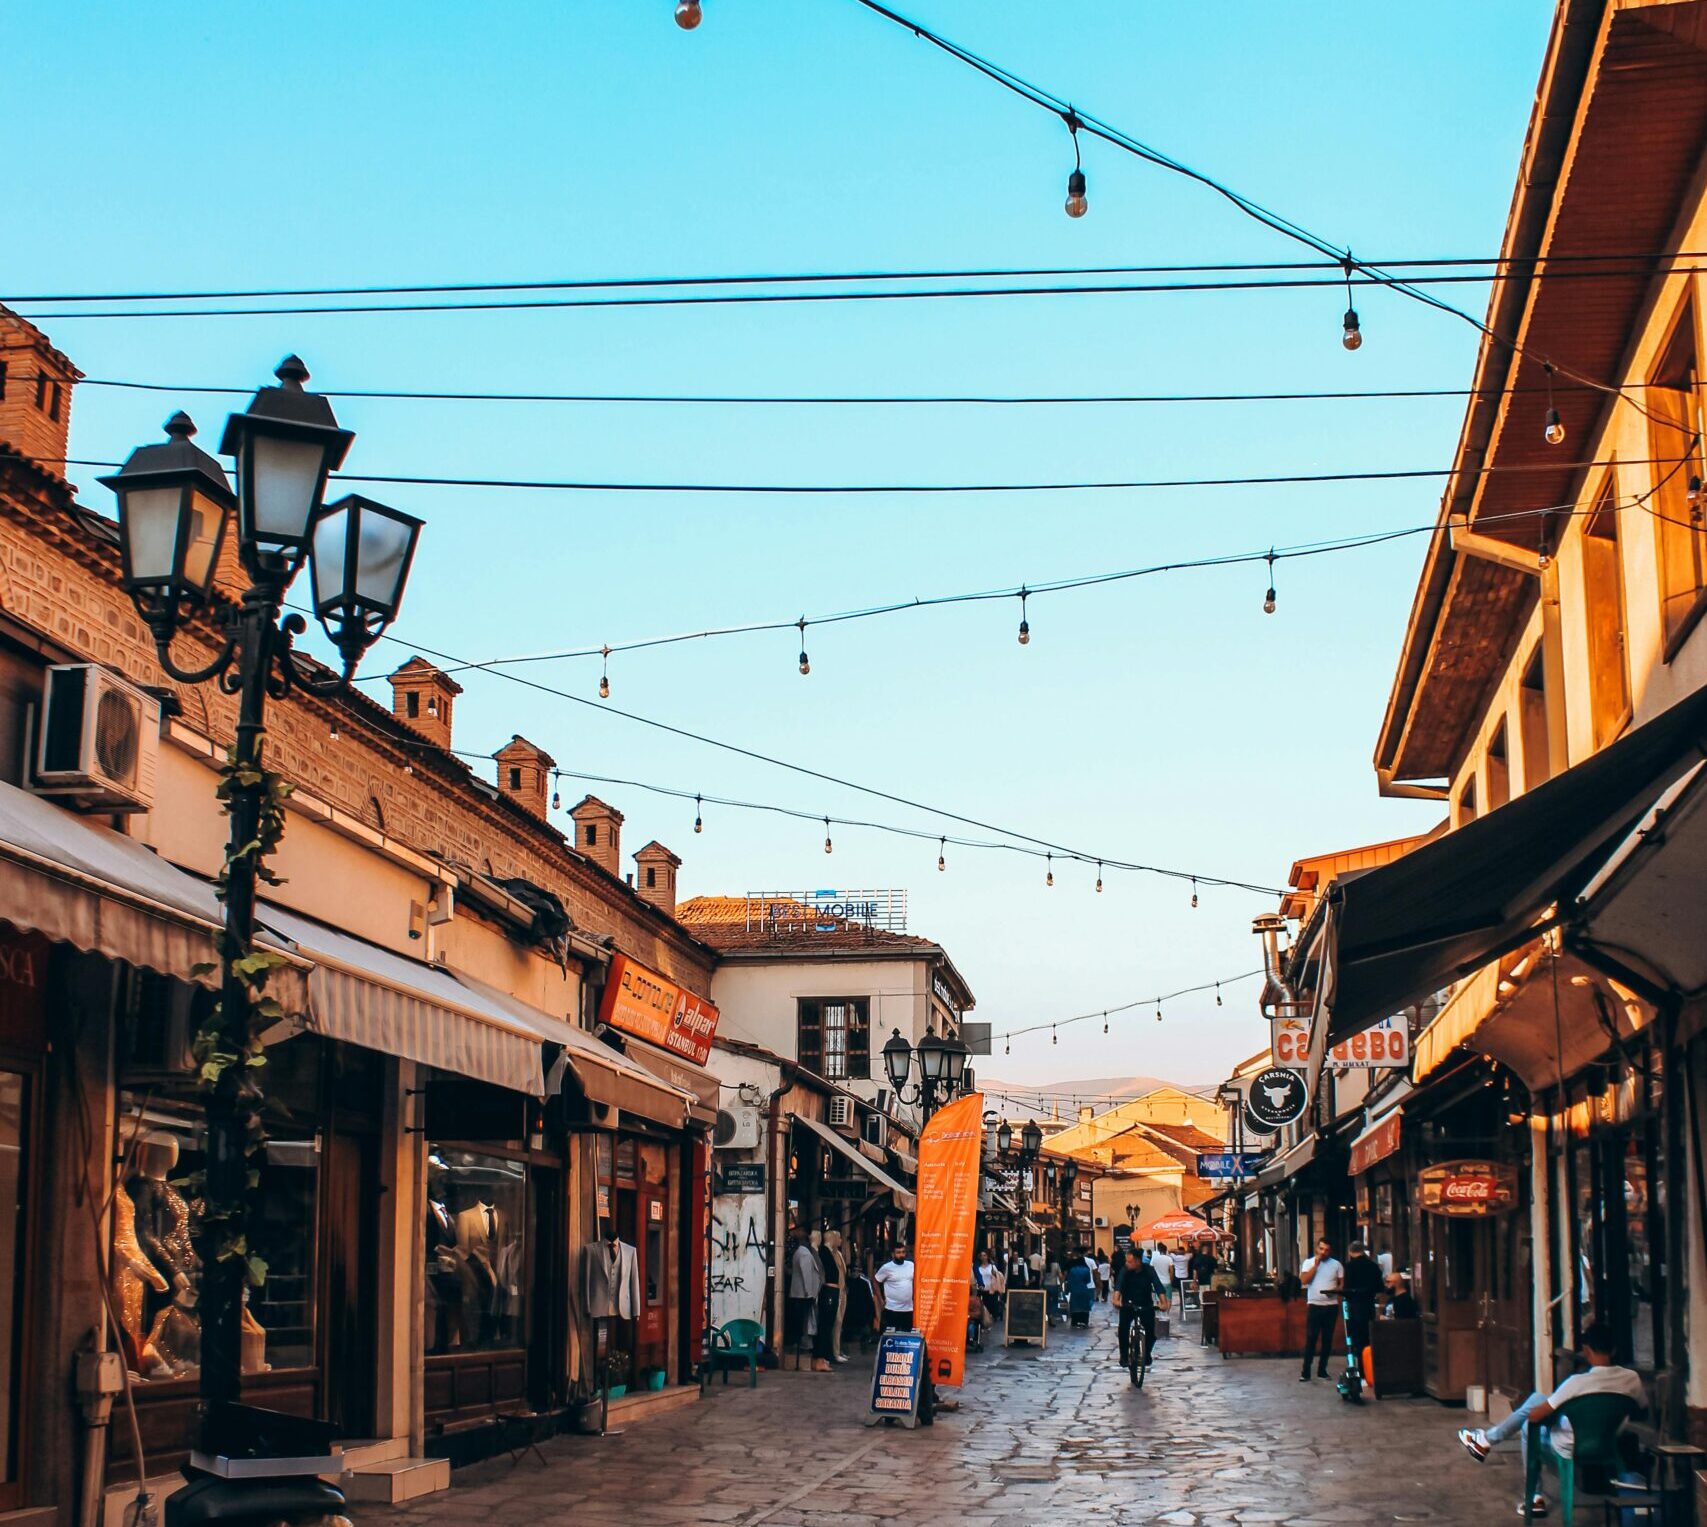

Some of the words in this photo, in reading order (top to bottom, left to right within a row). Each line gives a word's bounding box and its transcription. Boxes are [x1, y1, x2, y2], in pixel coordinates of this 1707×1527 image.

[772, 904, 810, 918] BEST
[816, 904, 878, 918] MOBILE
[684, 1002, 715, 1037] alpar
